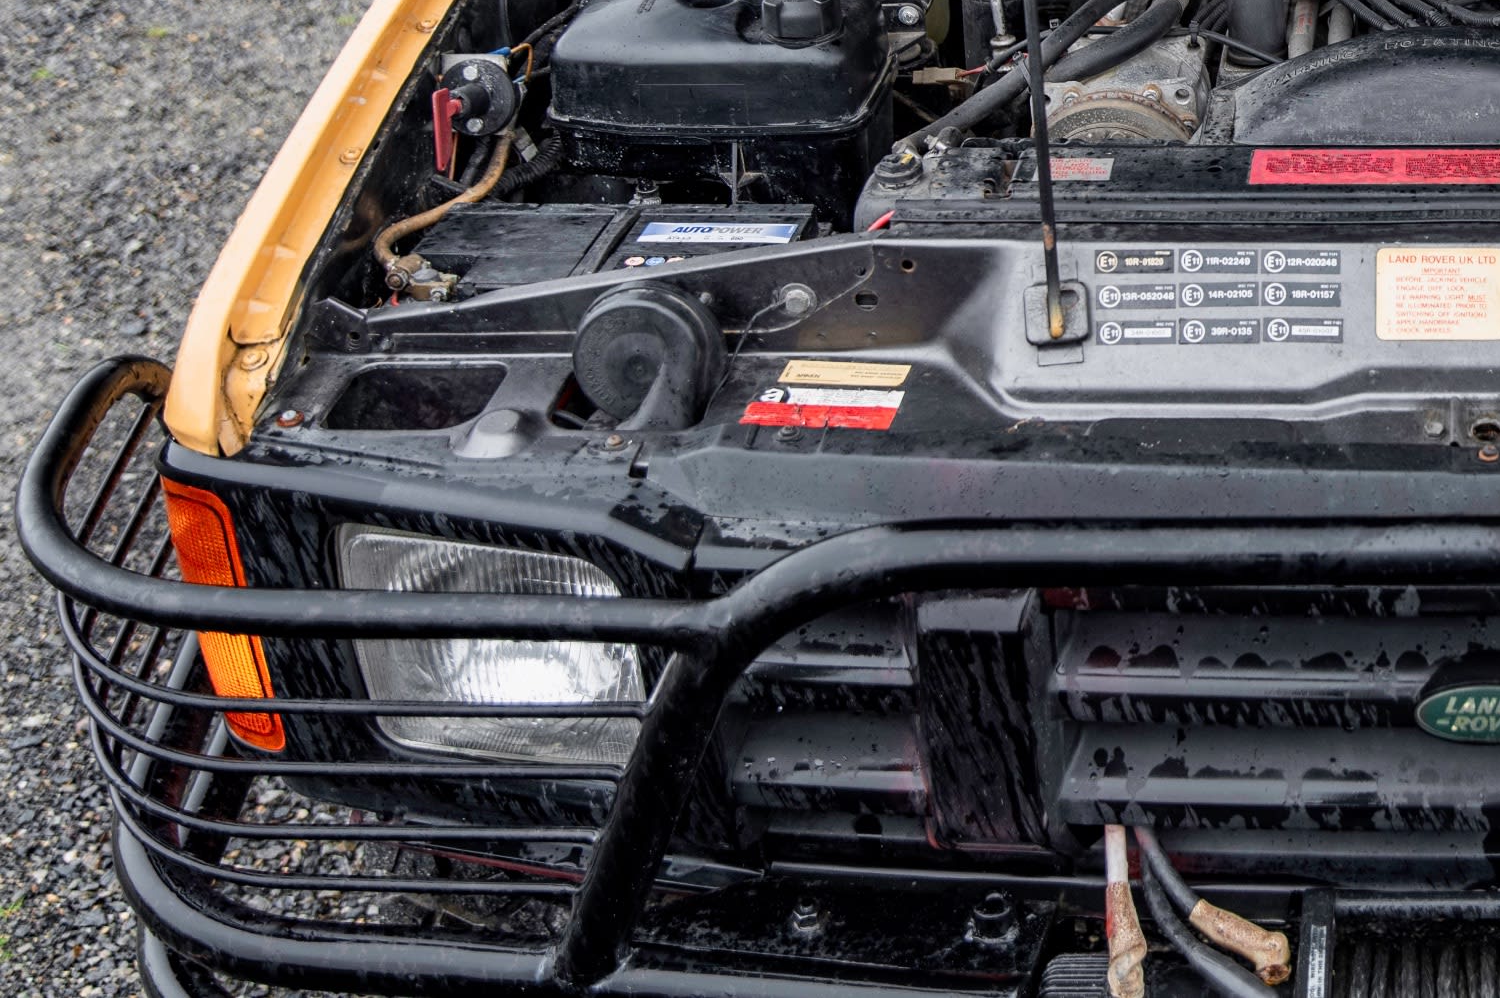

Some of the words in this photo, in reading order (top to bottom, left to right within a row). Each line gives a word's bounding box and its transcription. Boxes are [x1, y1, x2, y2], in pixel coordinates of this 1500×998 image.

[672, 226, 764, 234] AUTOPOWER
[1388, 255, 1417, 264] LAND
[1421, 255, 1456, 264] ROVER
[1459, 256, 1474, 264] UK
[1478, 256, 1496, 264] LTD
